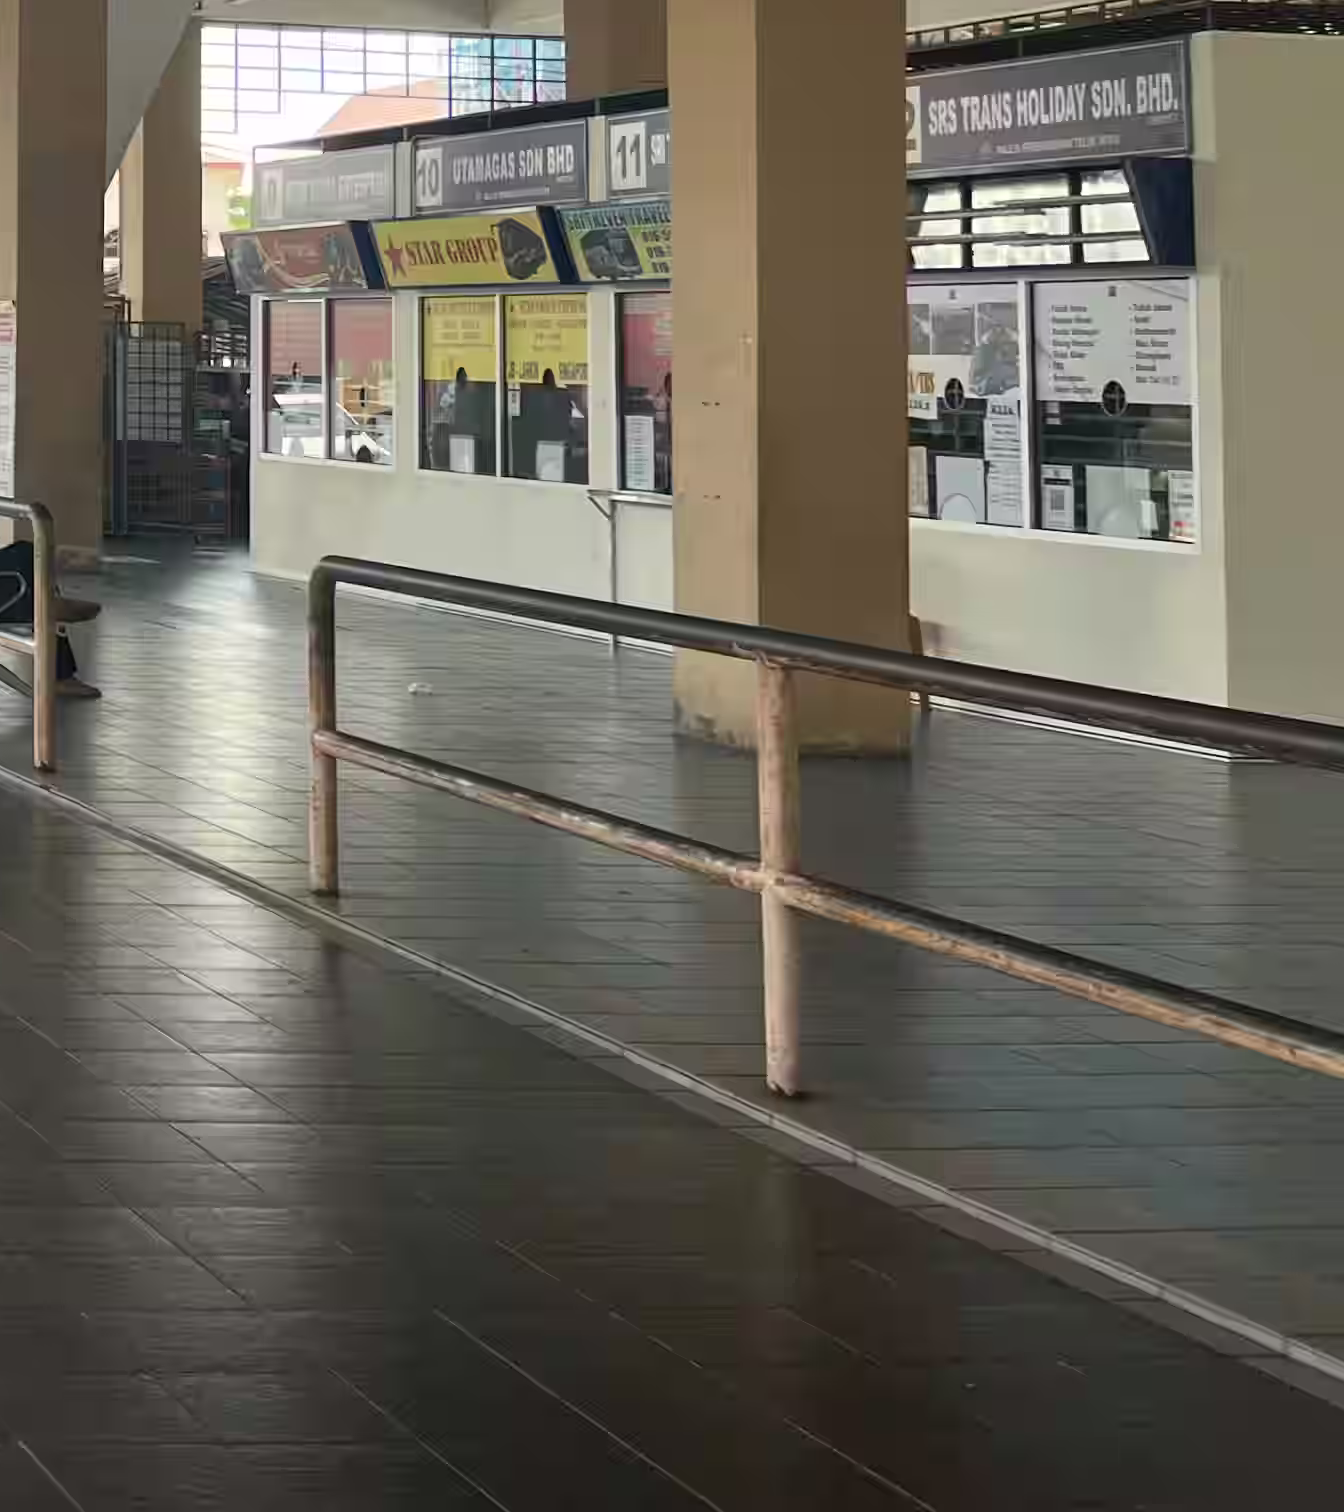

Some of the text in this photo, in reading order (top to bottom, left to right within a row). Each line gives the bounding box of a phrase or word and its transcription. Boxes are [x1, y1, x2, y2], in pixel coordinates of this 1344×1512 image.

[928, 73, 1179, 136] SRS TRANS HOLIDAY SDN. BHD.
[417, 158, 440, 198] 10
[453, 144, 574, 185] UTAMAGAS SDN BHD
[617, 134, 641, 183] 11
[406, 236, 499, 266] STAR GROUP
